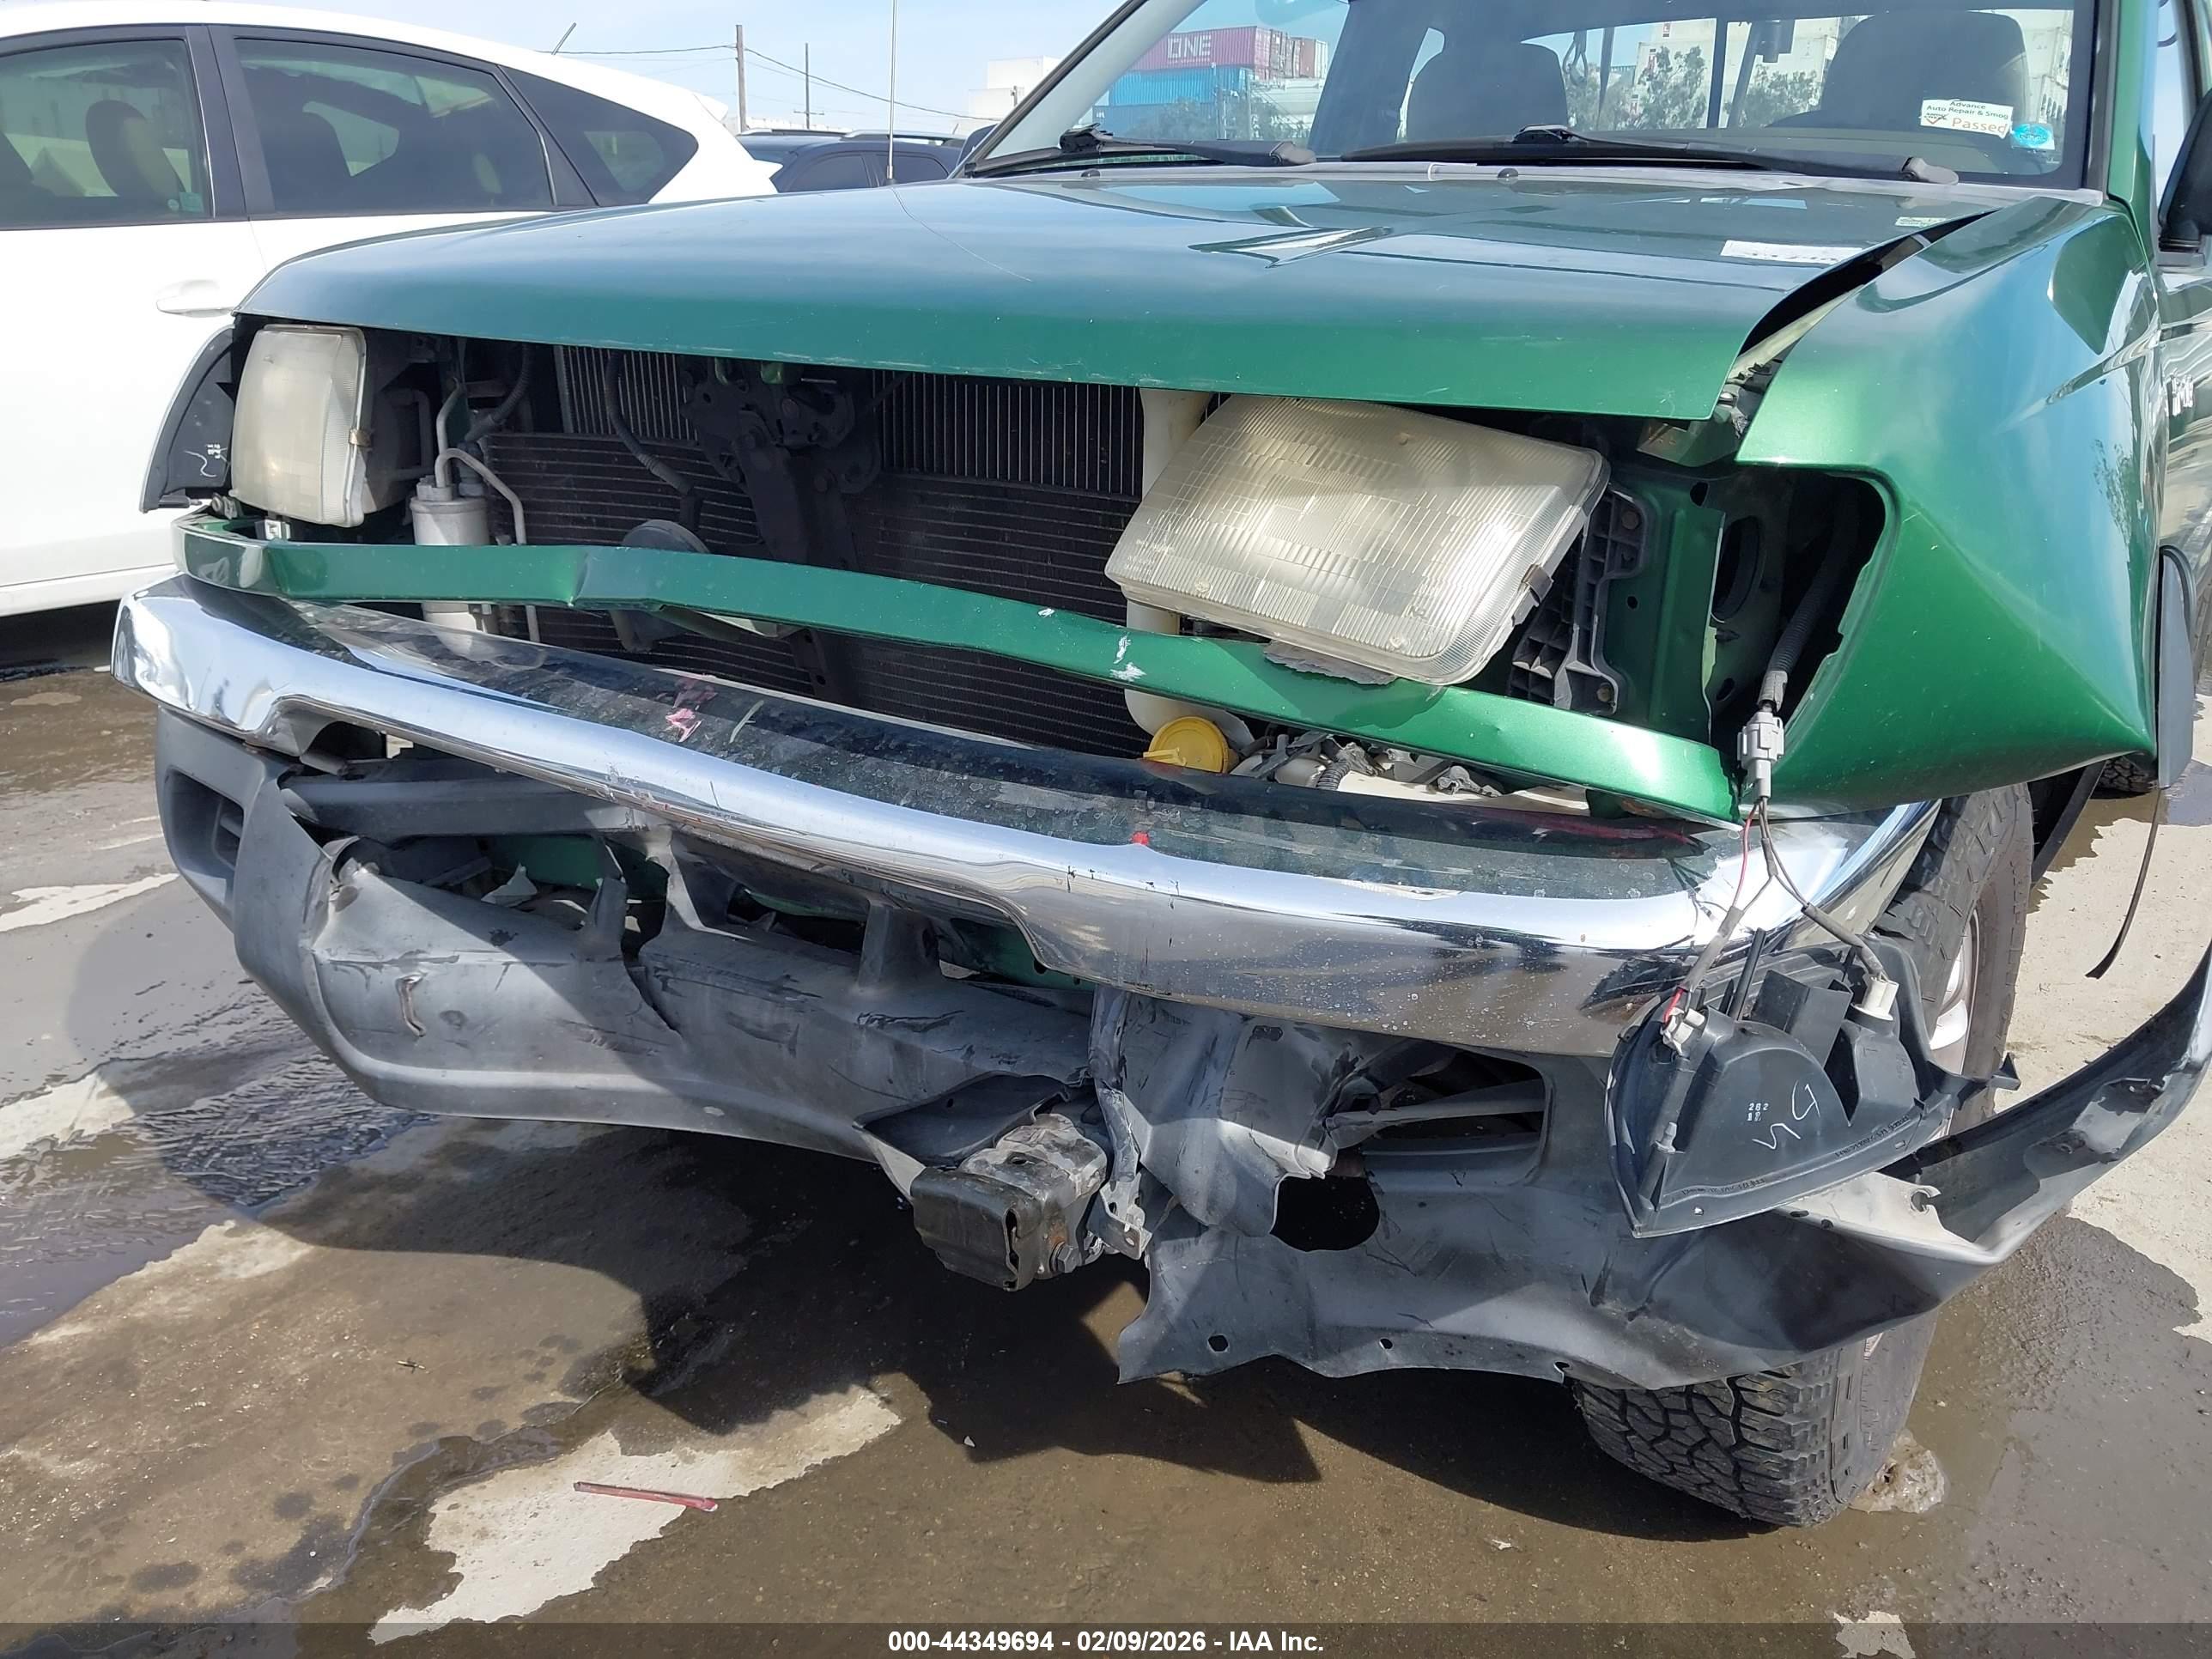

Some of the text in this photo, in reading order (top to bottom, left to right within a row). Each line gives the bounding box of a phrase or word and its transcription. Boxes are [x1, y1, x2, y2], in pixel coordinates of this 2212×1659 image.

[1167, 34, 1212, 58] ONE
[1949, 100, 1986, 110] Advance
[1985, 111, 2008, 120] Smog
[1952, 117, 2008, 133] Passed
